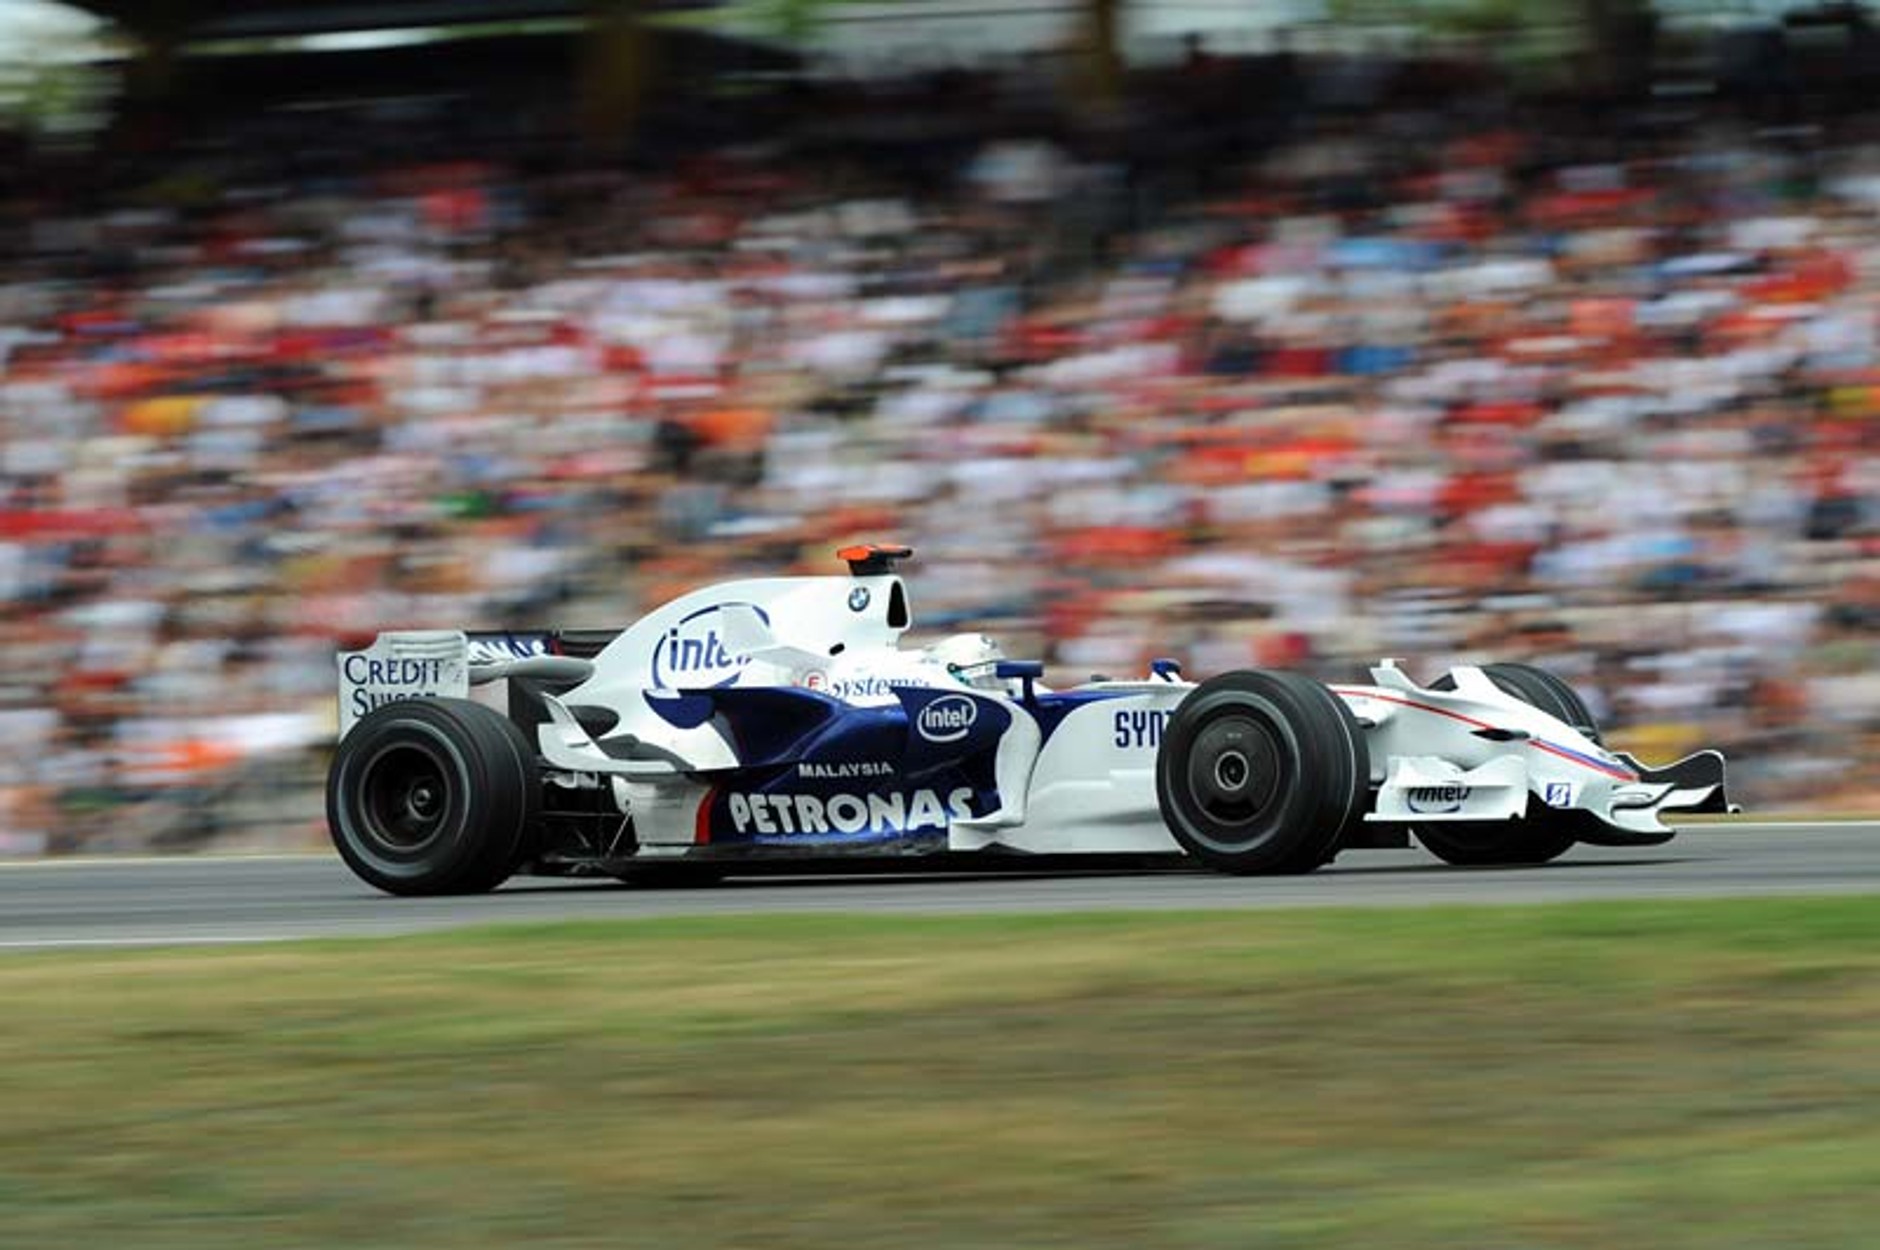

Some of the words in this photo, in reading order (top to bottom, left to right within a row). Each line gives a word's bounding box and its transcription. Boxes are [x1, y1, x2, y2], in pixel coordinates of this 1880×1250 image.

[669, 627, 743, 671] inte
[344, 655, 444, 685] CREDIT
[924, 704, 968, 728] intel
[798, 761, 894, 778] MALAYSIA
[728, 786, 974, 834] PETRONAS
